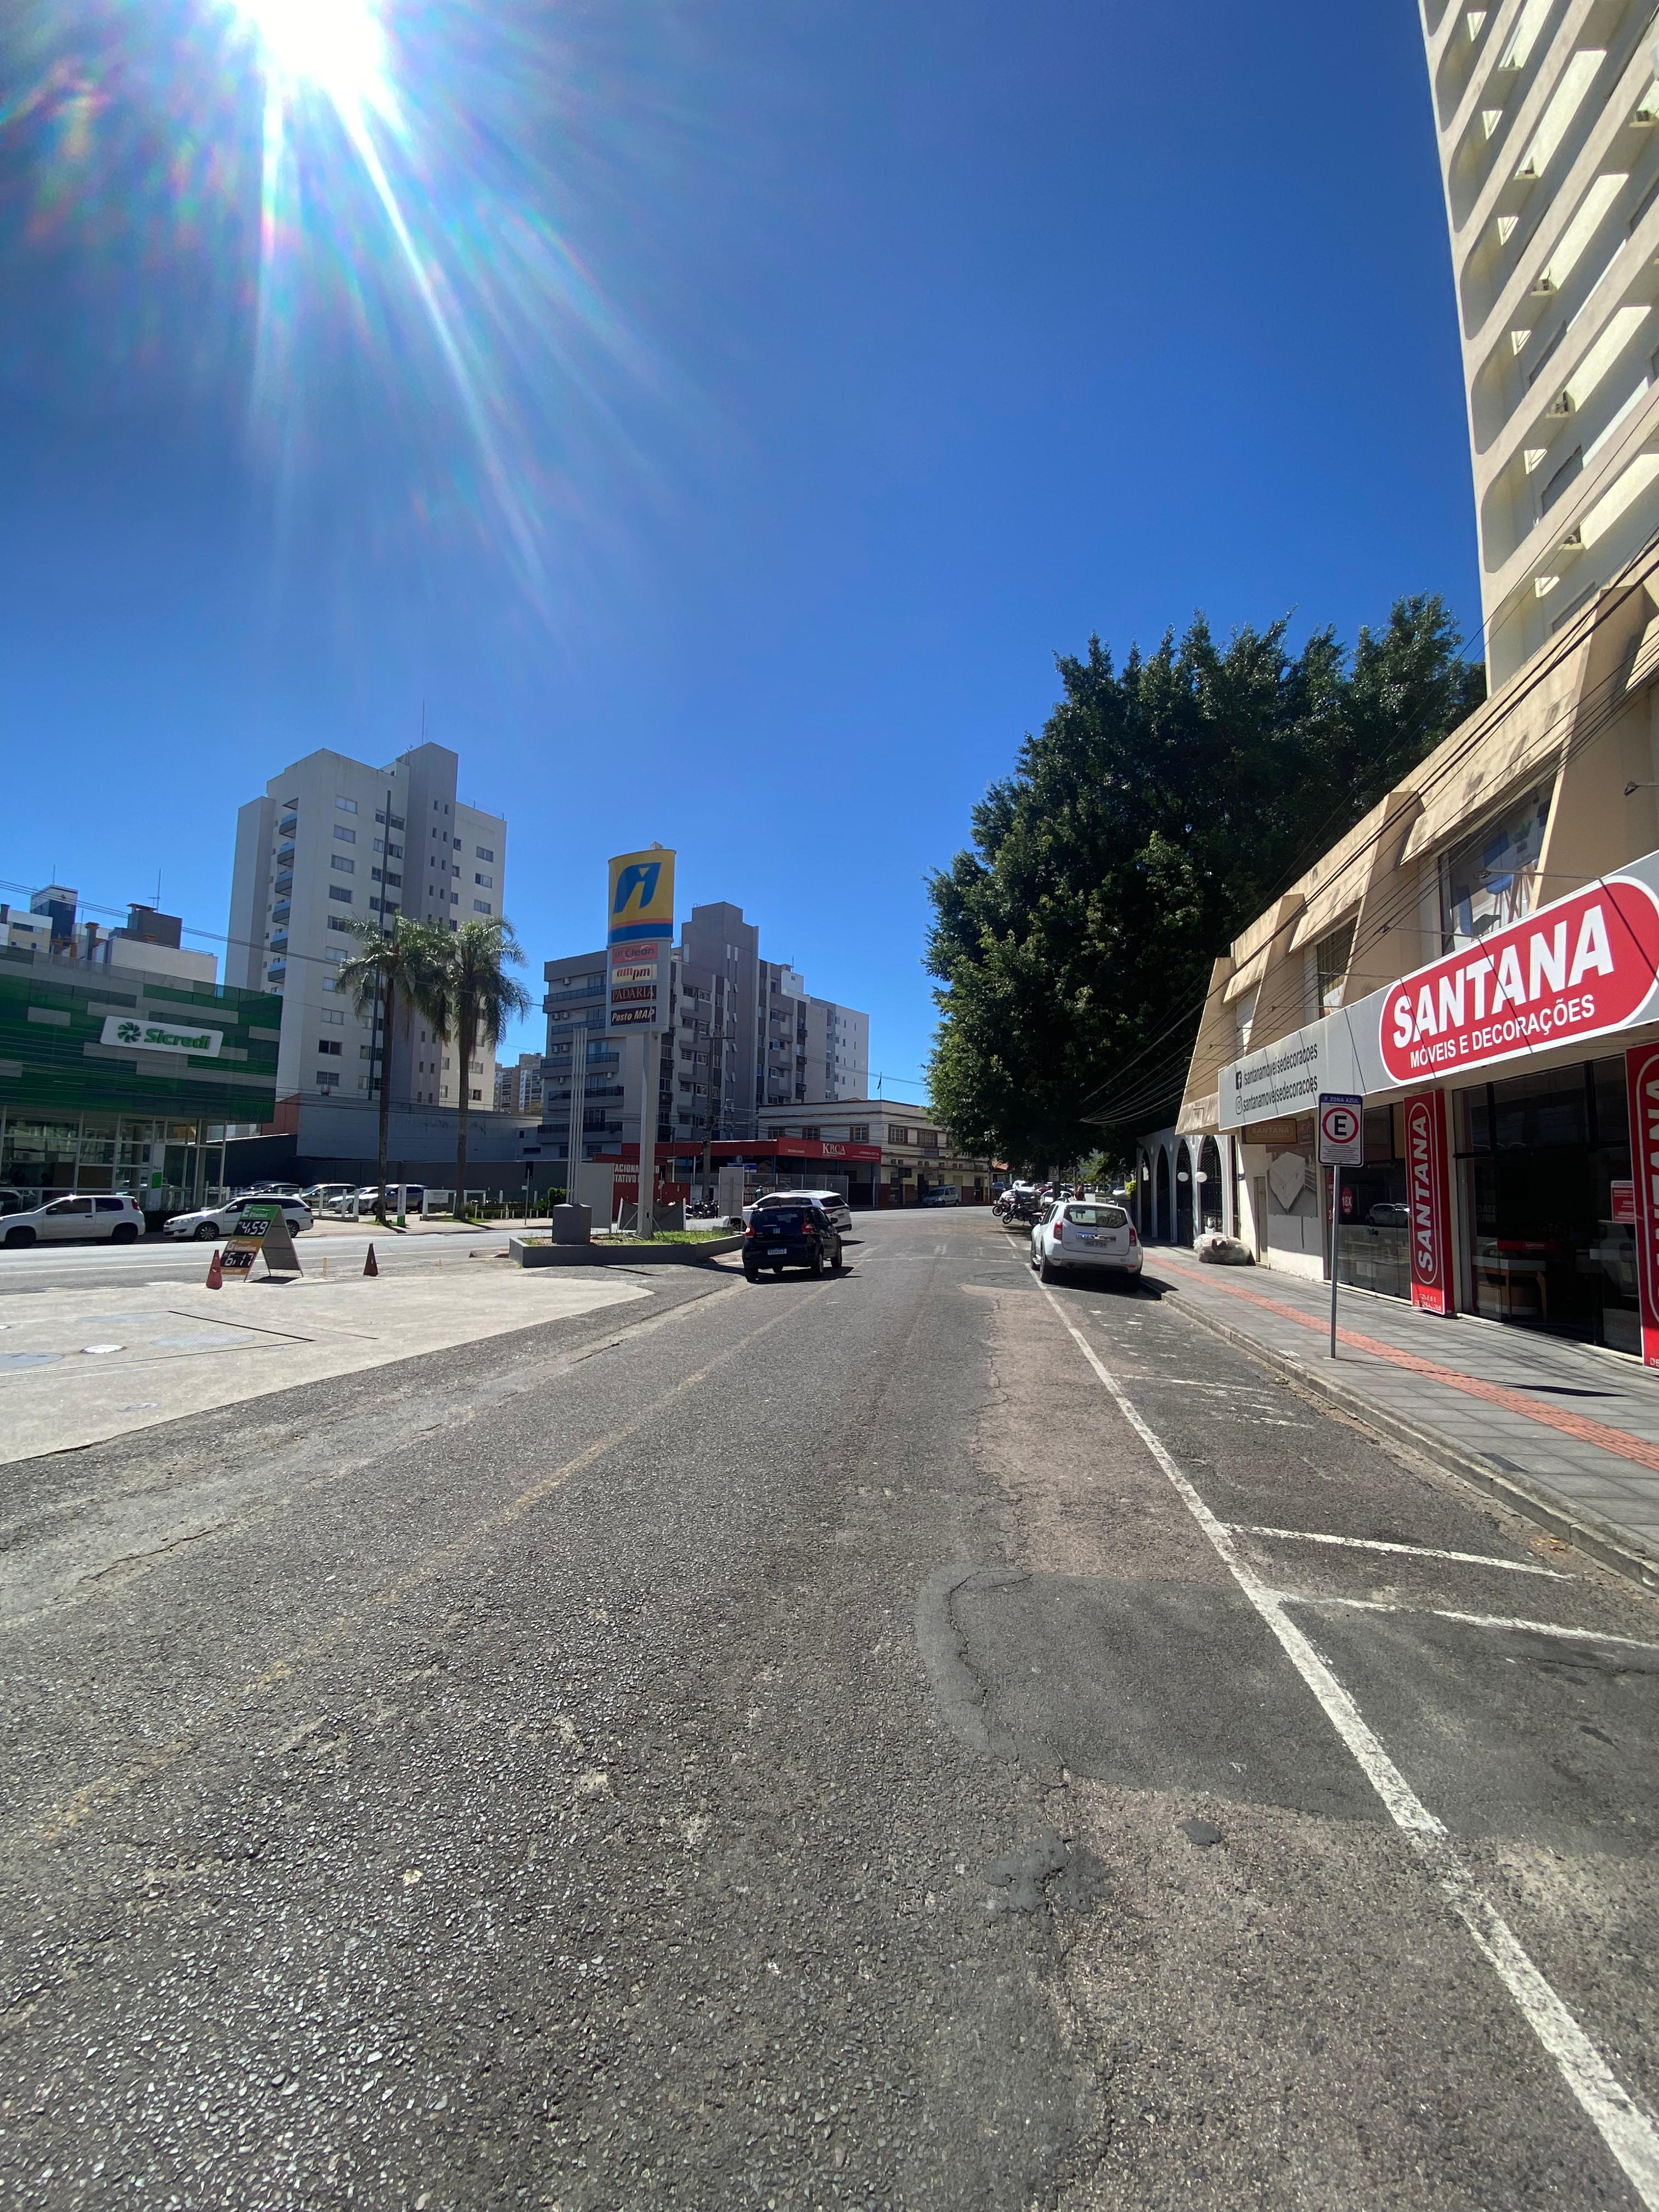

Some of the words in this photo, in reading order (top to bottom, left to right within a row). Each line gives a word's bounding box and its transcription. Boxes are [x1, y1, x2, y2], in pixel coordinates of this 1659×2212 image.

[625, 948, 654, 957] Clean
[617, 968, 650, 980] ampm
[1392, 904, 1615, 1048] SANTANA
[612, 986, 654, 1001] PADARIA
[612, 1013, 633, 1022] Posto
[634, 1009, 655, 1020] MAP
[144, 1028, 211, 1049] Sicredi
[1410, 1039, 1457, 1069] MÓVEIS
[1460, 1034, 1469, 1055] E
[1472, 994, 1595, 1051] DECORAÇÕES
[1334, 1115, 1347, 1136] E
[614, 1175, 636, 1183] TATIVO
[1412, 1115, 1433, 1272] SANTANA
[1342, 1196, 1352, 1207] 18X
